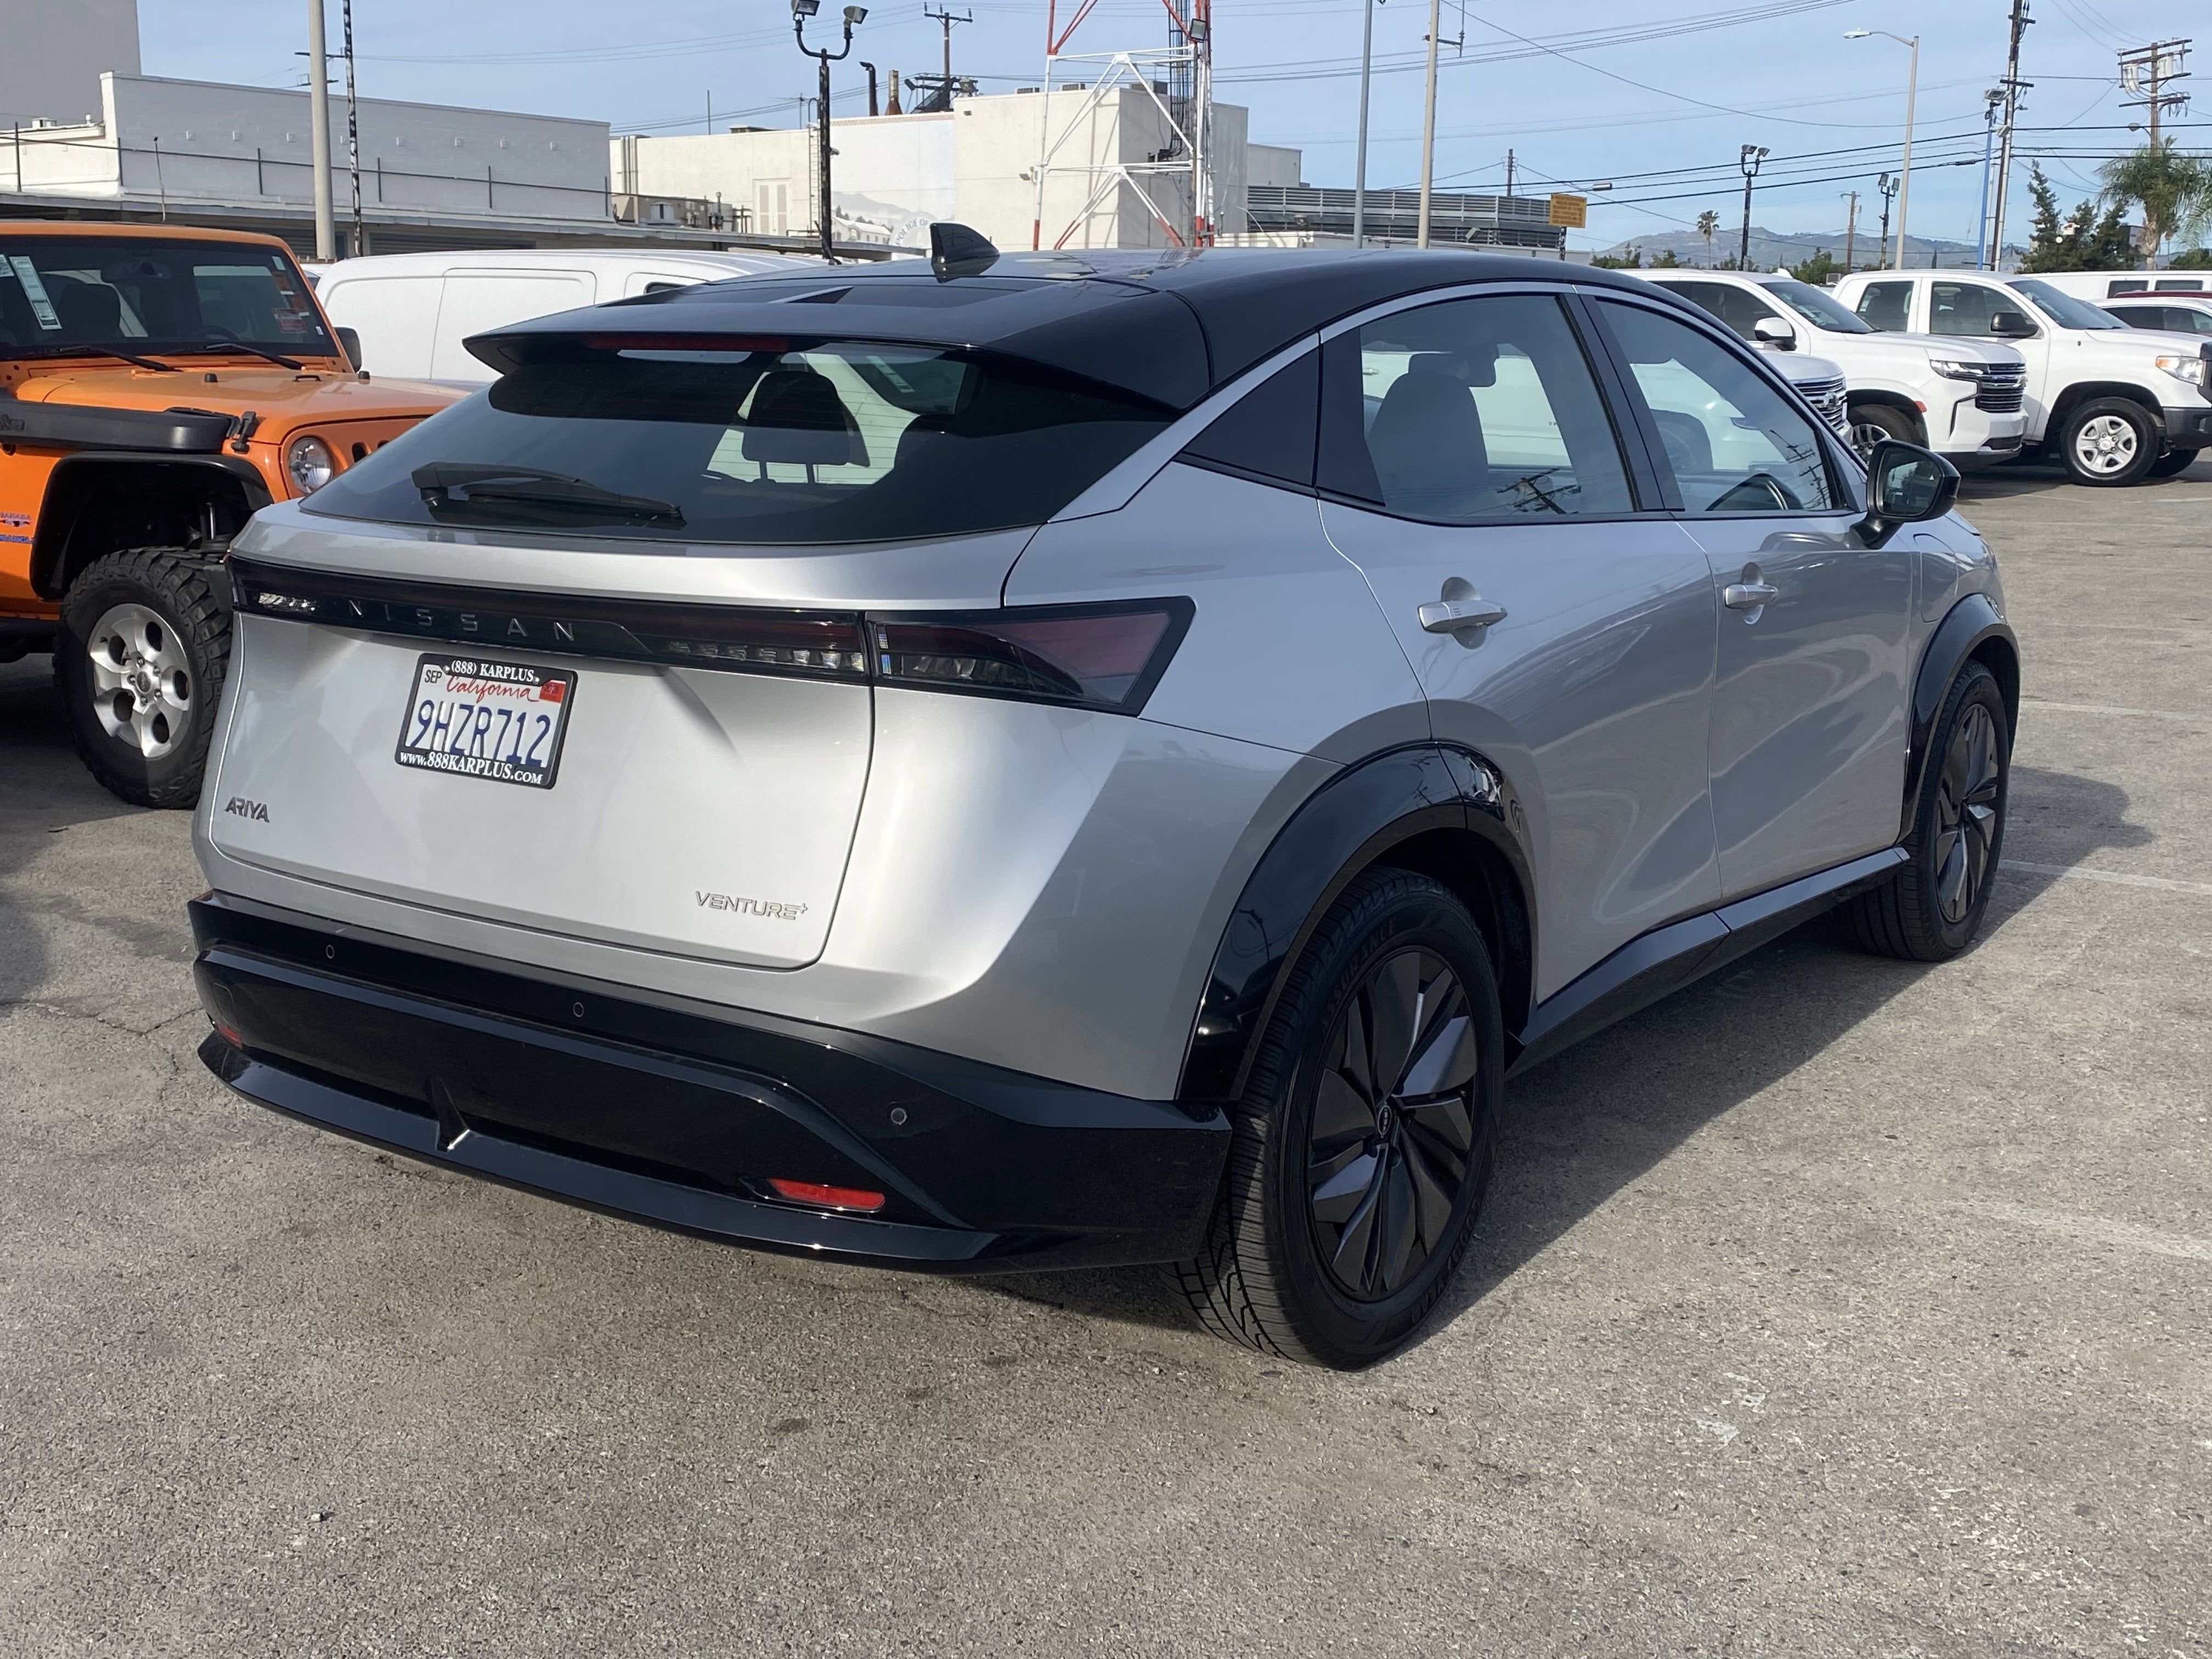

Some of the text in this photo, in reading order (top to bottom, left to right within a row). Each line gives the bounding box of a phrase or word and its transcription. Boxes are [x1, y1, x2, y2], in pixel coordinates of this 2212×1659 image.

[895, 219, 918, 245] POLICE
[348, 599, 576, 642] NISSAN
[424, 669, 442, 684] SEP
[451, 659, 535, 682] (888) KARPLUS
[446, 674, 539, 704] California
[410, 699, 551, 768] 9HZR712
[224, 796, 270, 823] ARIYA
